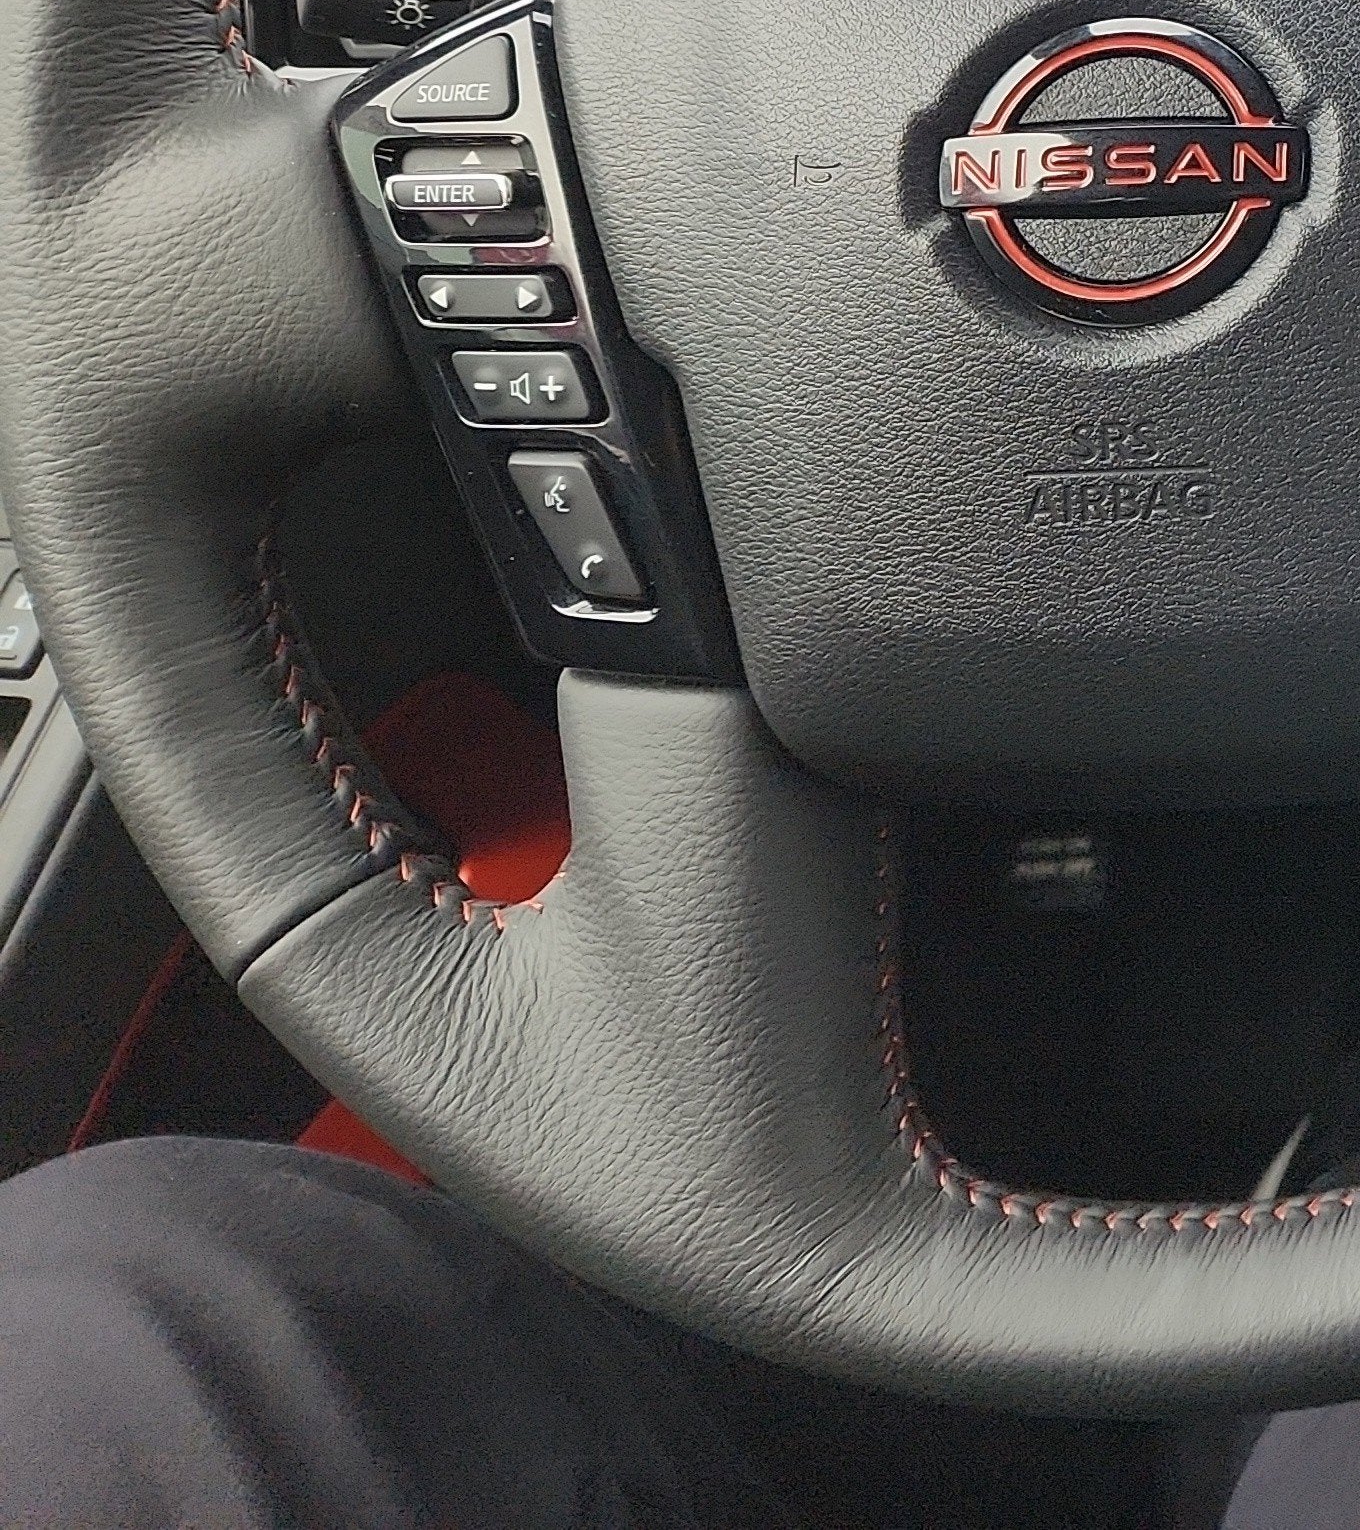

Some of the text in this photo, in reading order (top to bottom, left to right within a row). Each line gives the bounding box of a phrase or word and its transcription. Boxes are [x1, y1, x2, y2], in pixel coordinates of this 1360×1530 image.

[416, 82, 490, 103] SOURCE
[951, 141, 1289, 195] NISSAN
[413, 184, 476, 205] ENTER
[1068, 422, 1160, 463] SRS
[1023, 482, 1215, 523] AIRBAG
